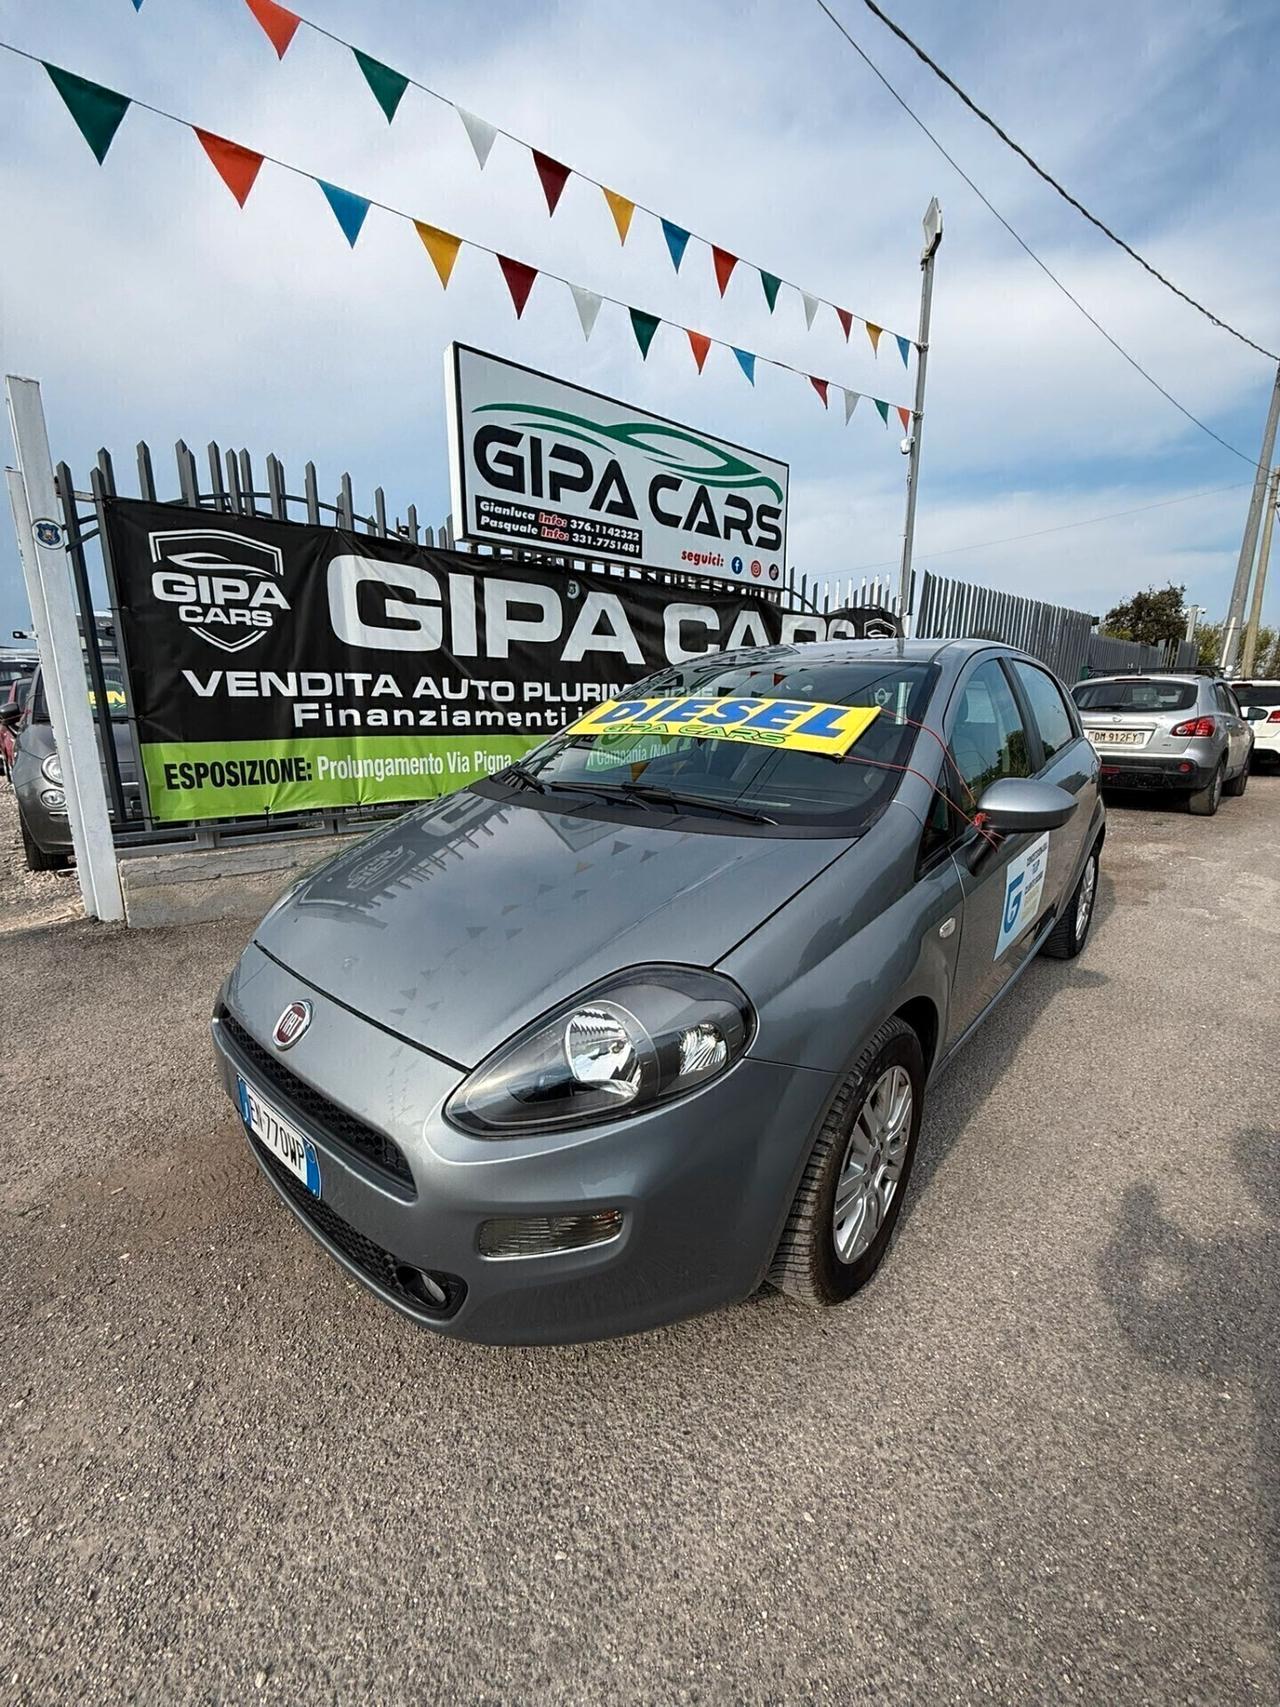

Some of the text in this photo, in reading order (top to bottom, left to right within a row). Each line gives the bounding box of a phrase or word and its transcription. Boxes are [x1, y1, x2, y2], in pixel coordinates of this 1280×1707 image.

[473, 424, 782, 552] GIPA CARS
[480, 501, 640, 541] Gianluca Info: 376.1142322
[480, 515, 538, 535] Pasquale
[540, 526, 570, 541] Info:
[681, 550, 724, 567] seguici:
[152, 571, 291, 610] GIPA
[179, 605, 273, 627] CARS
[327, 554, 646, 665] GIPA
[181, 669, 403, 698] VENDITA
[412, 676, 515, 702] AUTO
[293, 703, 566, 728] Finanziamenti
[590, 699, 850, 737] DIESEL
[679, 724, 788, 745] CARS
[164, 756, 312, 790] ESPOSIZIONE:
[317, 752, 443, 783] Prolungamento
[447, 751, 470, 773] Via
[279, 1010, 303, 1037] FIAT
